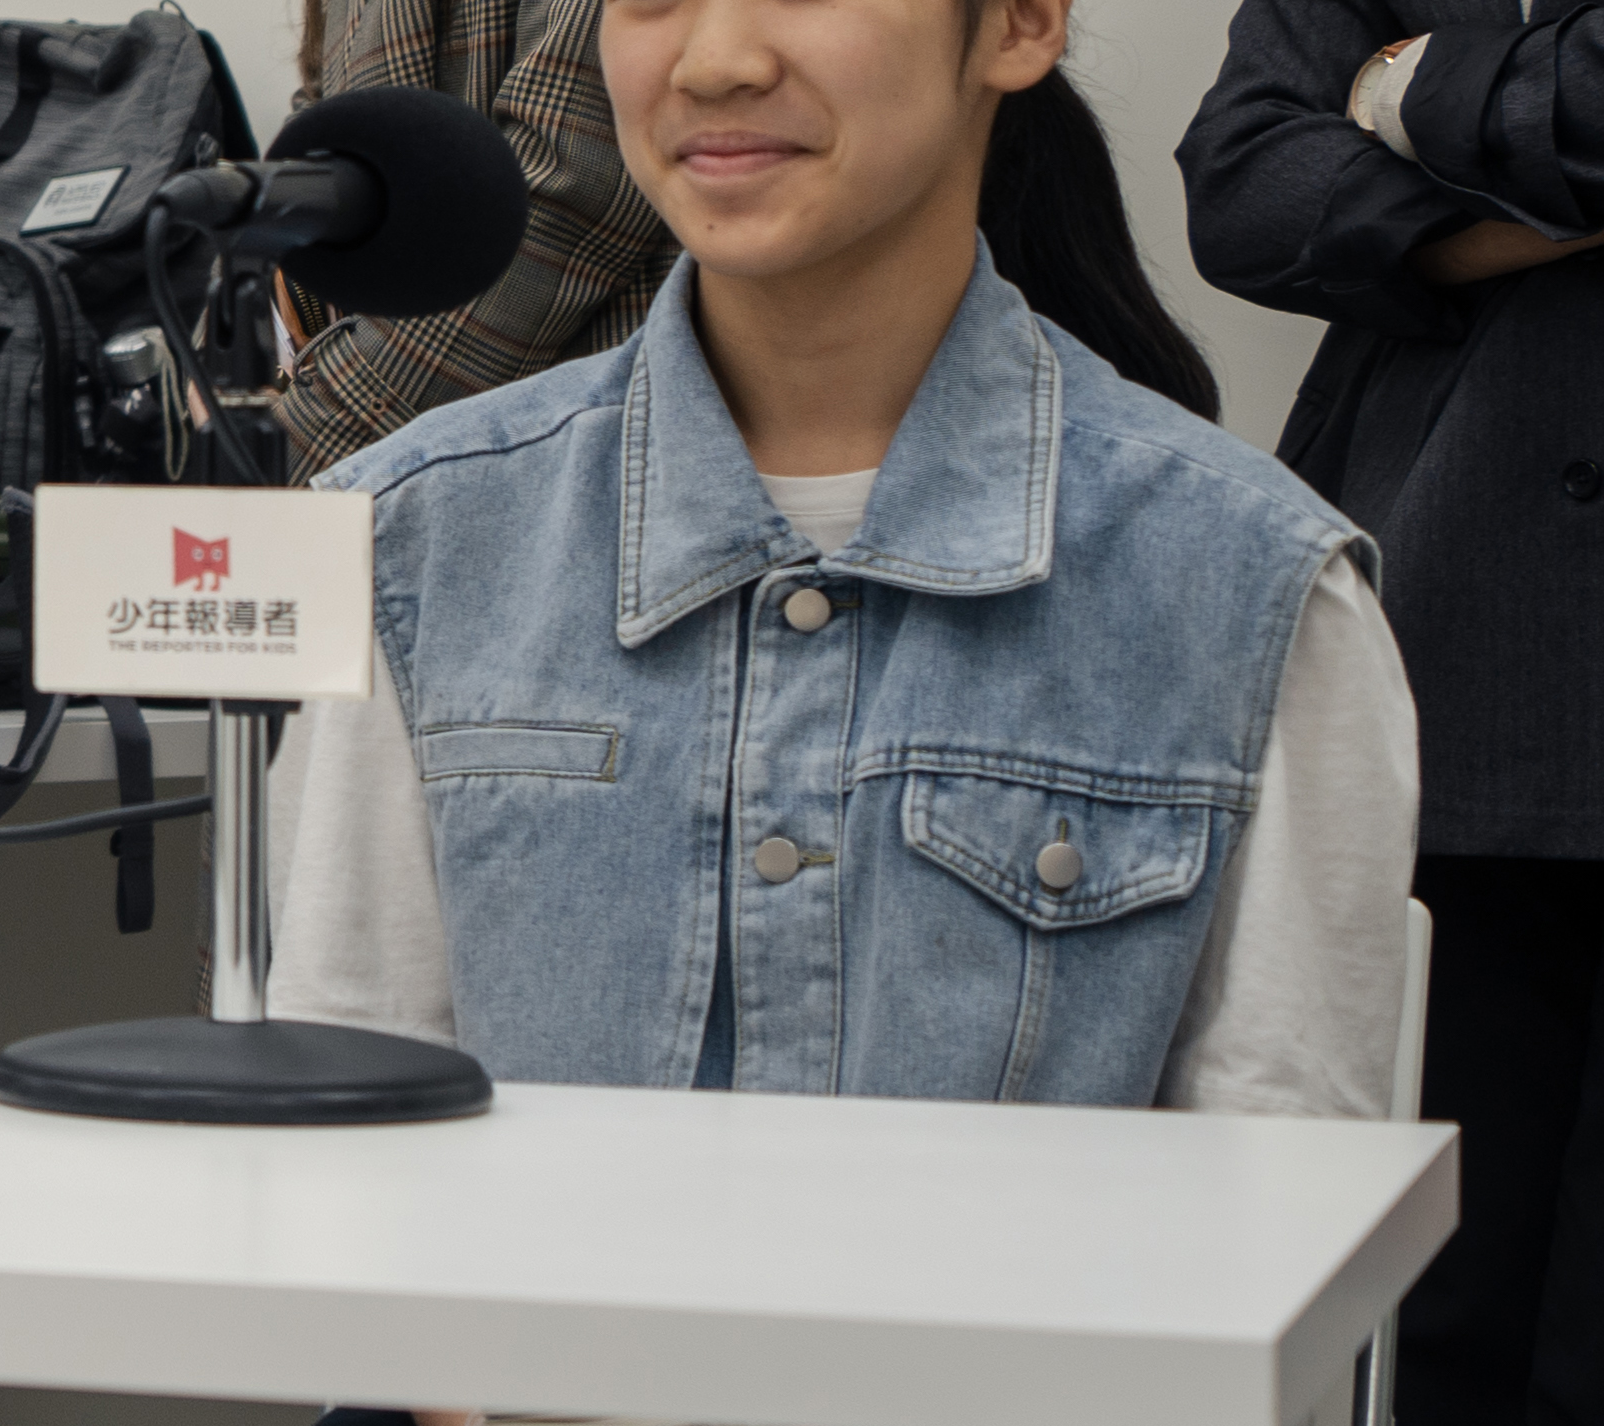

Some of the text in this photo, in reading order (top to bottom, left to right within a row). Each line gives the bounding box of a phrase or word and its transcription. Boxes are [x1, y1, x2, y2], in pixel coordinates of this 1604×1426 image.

[106, 597, 298, 636] 少年報導者
[109, 640, 138, 652] THE
[141, 641, 223, 653] REPORTER
[227, 642, 258, 653] FOR
